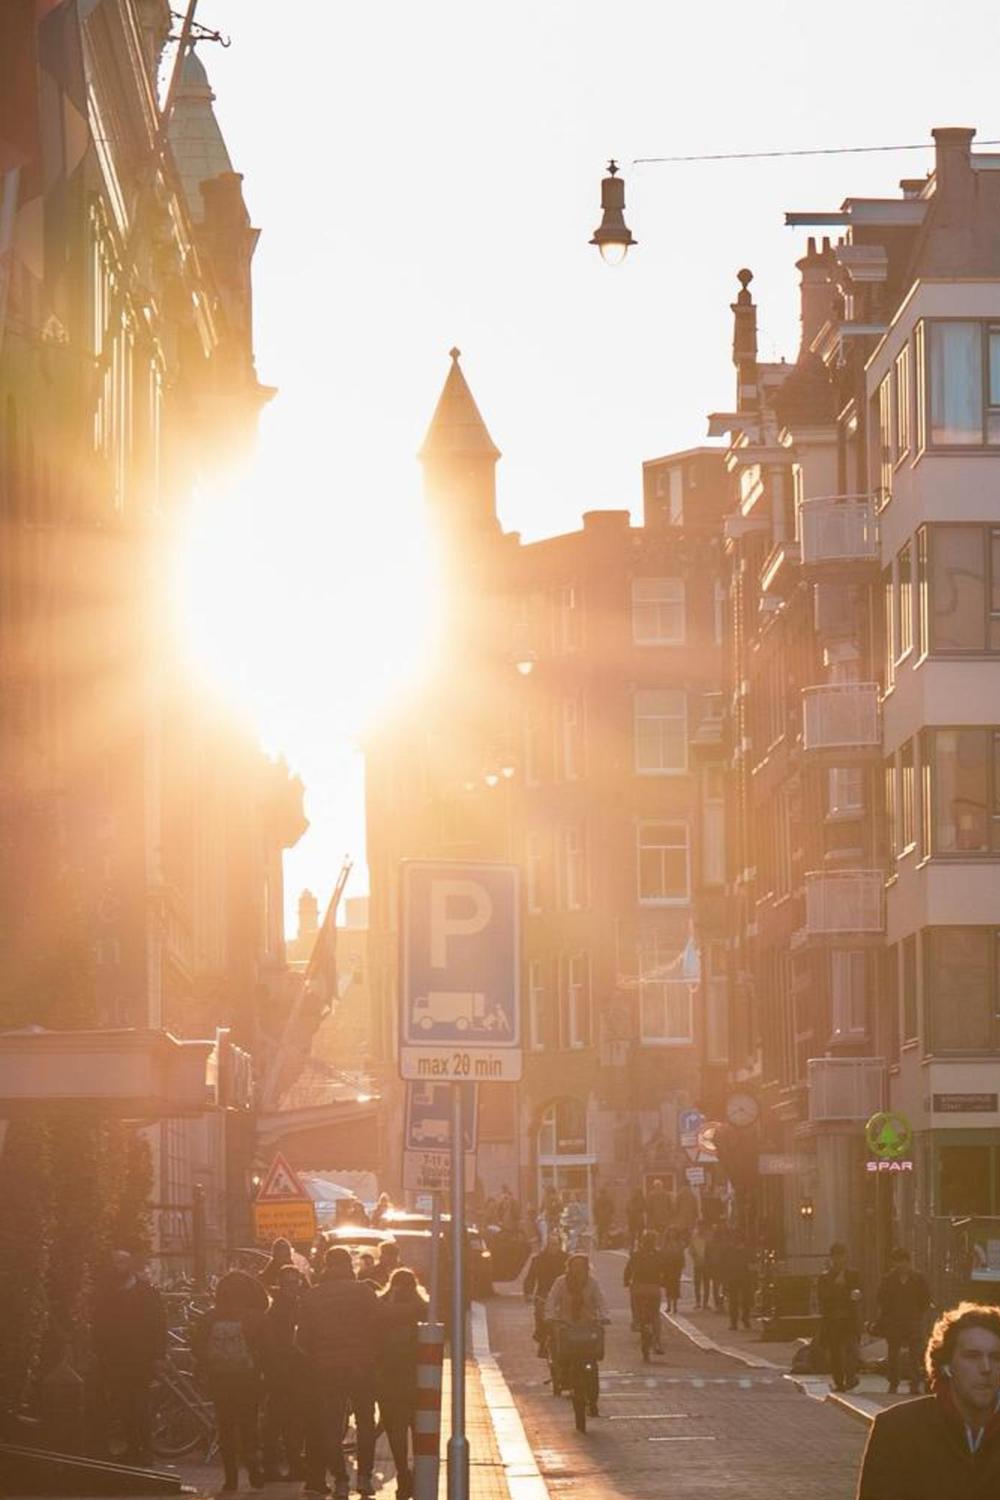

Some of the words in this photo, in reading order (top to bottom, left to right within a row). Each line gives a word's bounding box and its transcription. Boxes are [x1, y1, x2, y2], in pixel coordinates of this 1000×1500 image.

[431, 880, 493, 969] P
[417, 1058, 449, 1075] max
[453, 1054, 471, 1075] 20
[475, 1054, 502, 1076] min
[866, 1161, 913, 1171] SPAR
